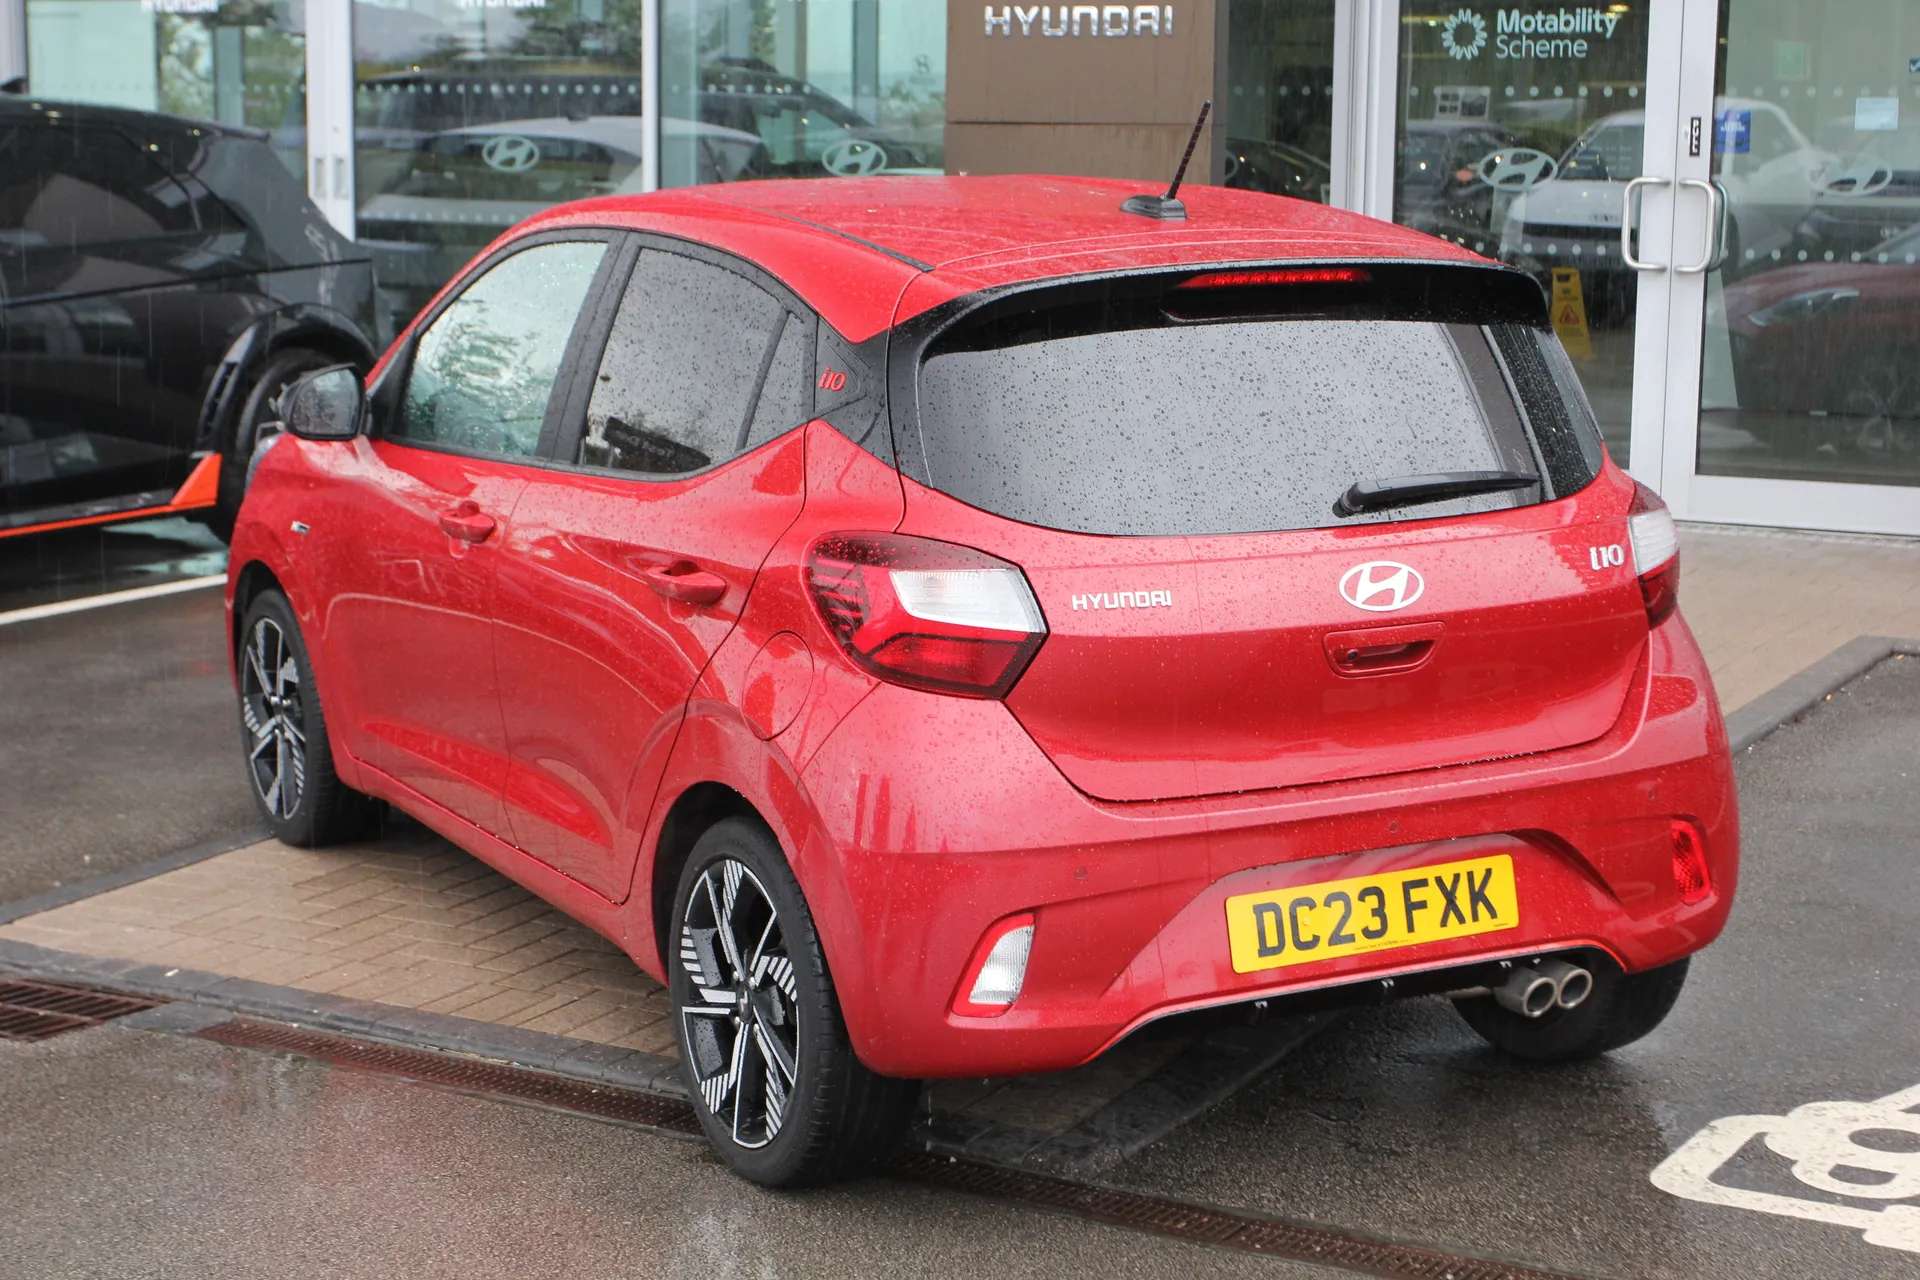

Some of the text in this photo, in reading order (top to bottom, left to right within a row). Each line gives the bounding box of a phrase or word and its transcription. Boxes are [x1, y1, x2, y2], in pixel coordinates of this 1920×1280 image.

[984, 5, 1173, 37] HYUNDAI
[1497, 8, 1620, 39] Motability
[1496, 35, 1588, 60] Scheme
[1071, 590, 1172, 611] HYUNDAI
[1253, 868, 1499, 957] DC23 FXK
